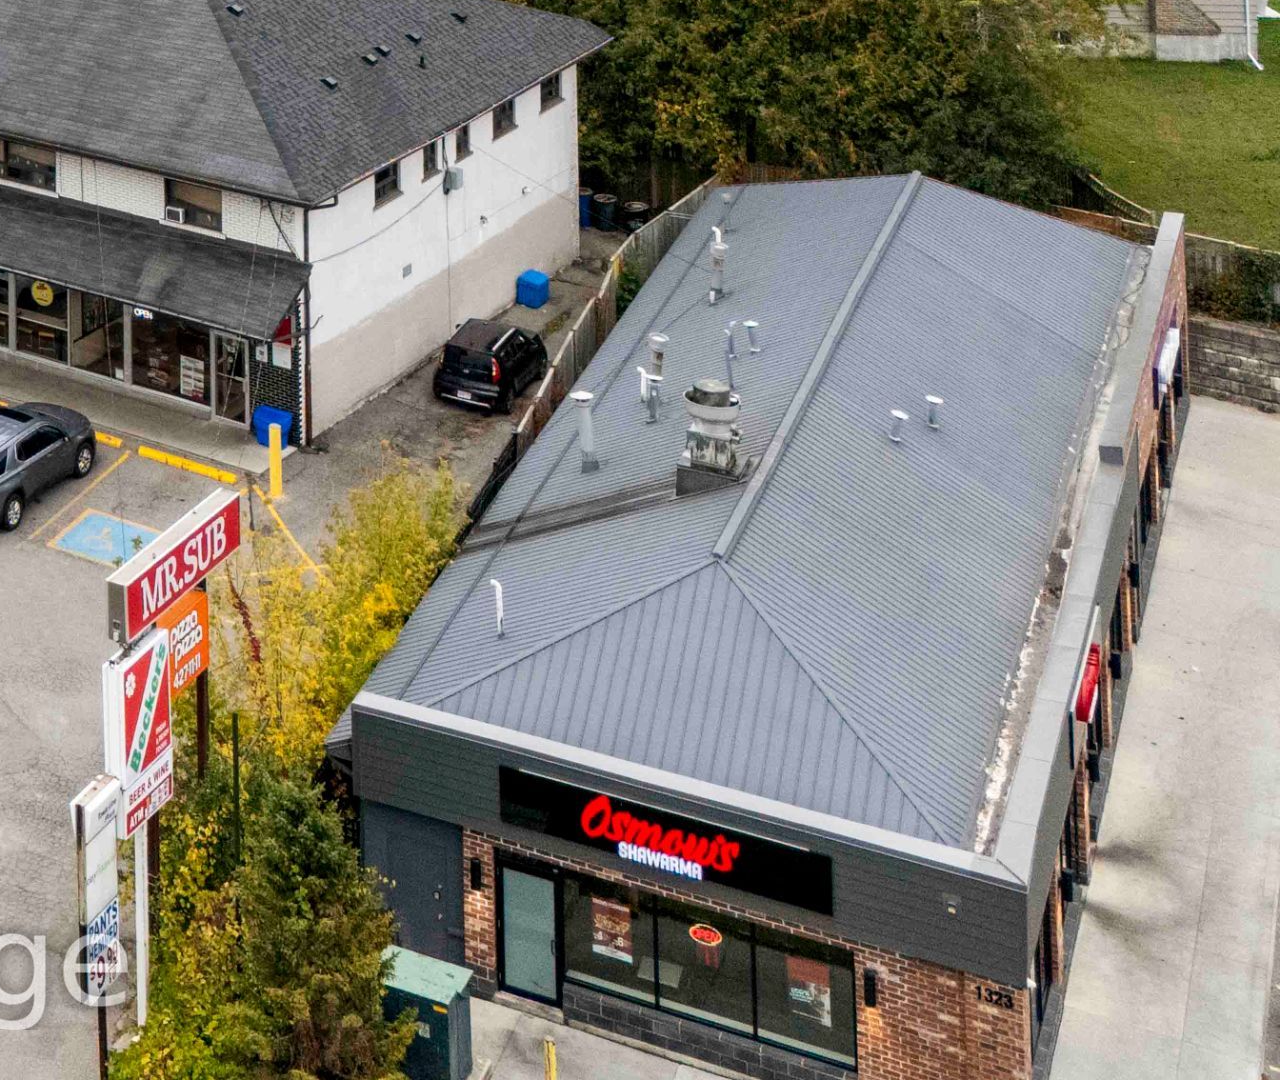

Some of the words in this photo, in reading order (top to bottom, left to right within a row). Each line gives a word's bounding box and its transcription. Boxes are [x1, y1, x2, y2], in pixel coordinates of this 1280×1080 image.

[134, 308, 154, 320] OPEN
[129, 782, 146, 806] BEER
[153, 760, 170, 784] WINE
[618, 840, 703, 880] SHAWARMA
[88, 900, 118, 934] PANTS
[692, 927, 719, 943] OPEN
[975, 985, 1014, 1009] 1323
